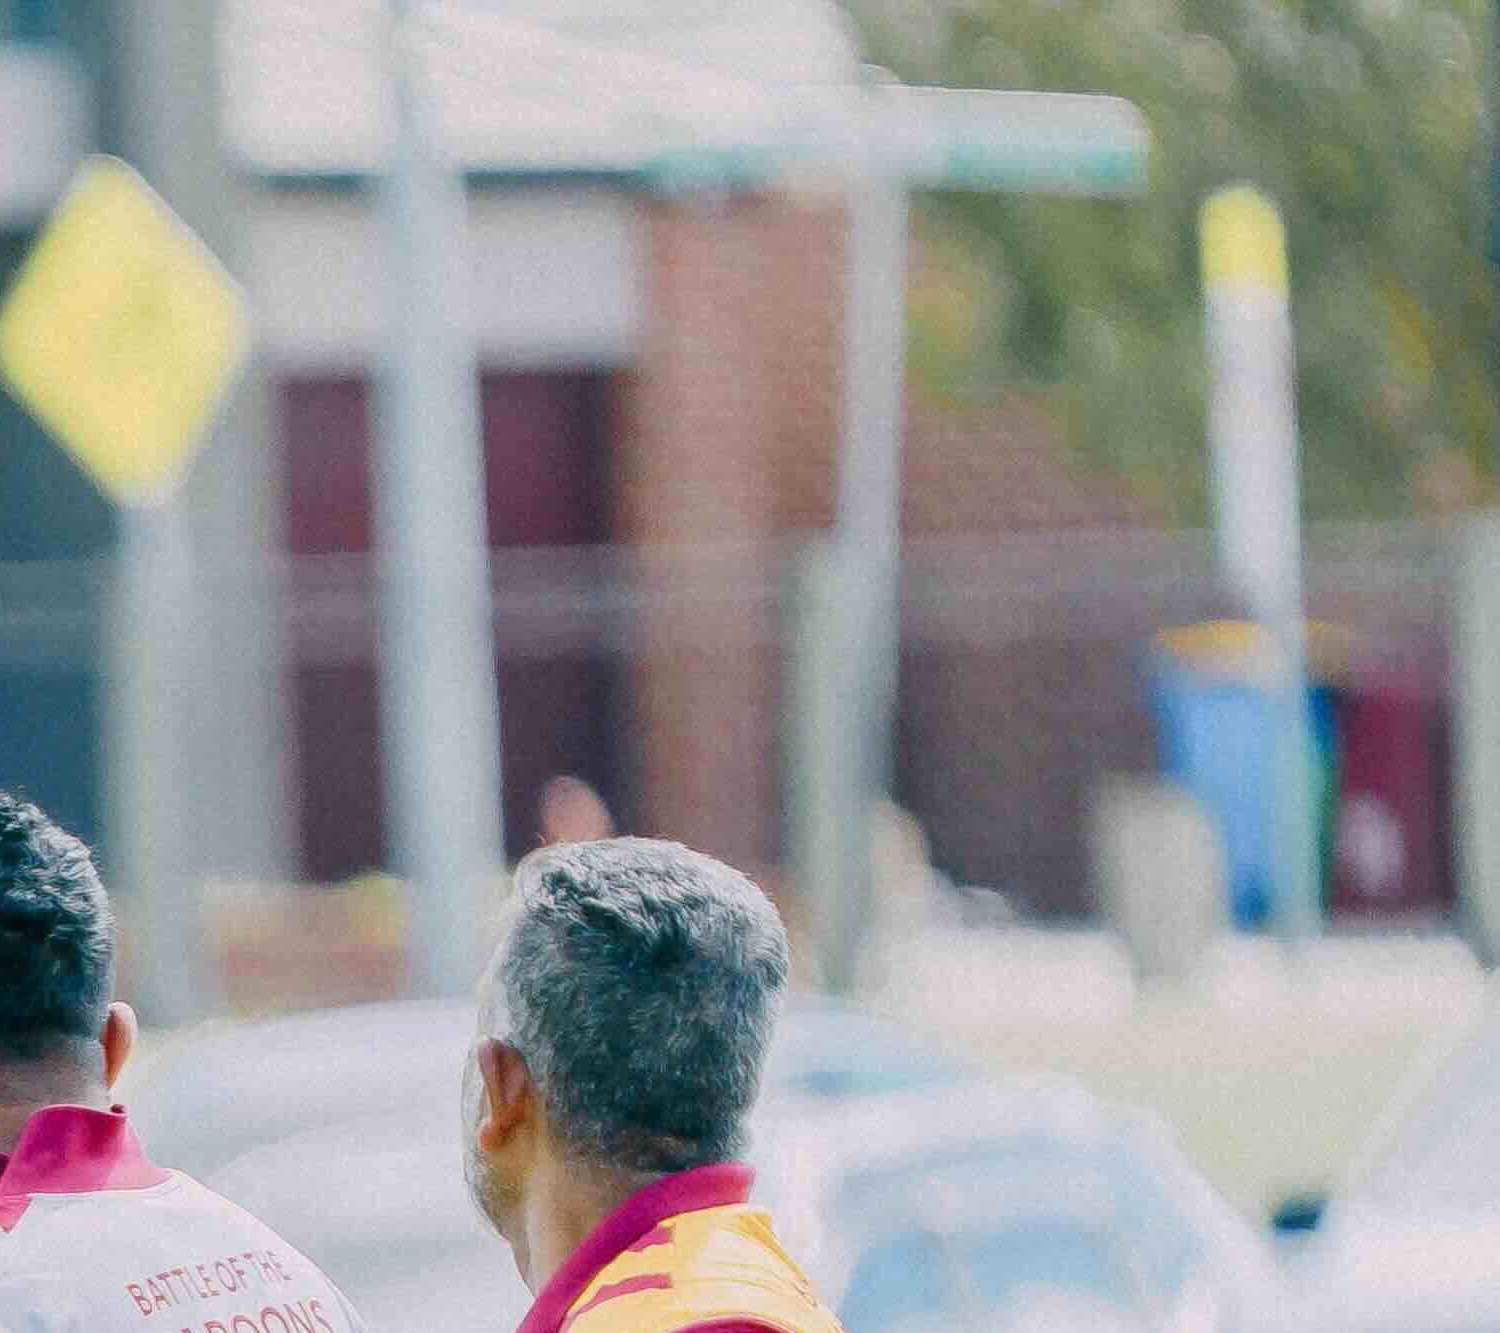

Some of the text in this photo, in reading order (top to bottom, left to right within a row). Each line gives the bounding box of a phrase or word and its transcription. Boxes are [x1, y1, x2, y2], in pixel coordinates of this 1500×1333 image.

[125, 1250, 293, 1316] BATTLE OF THE
